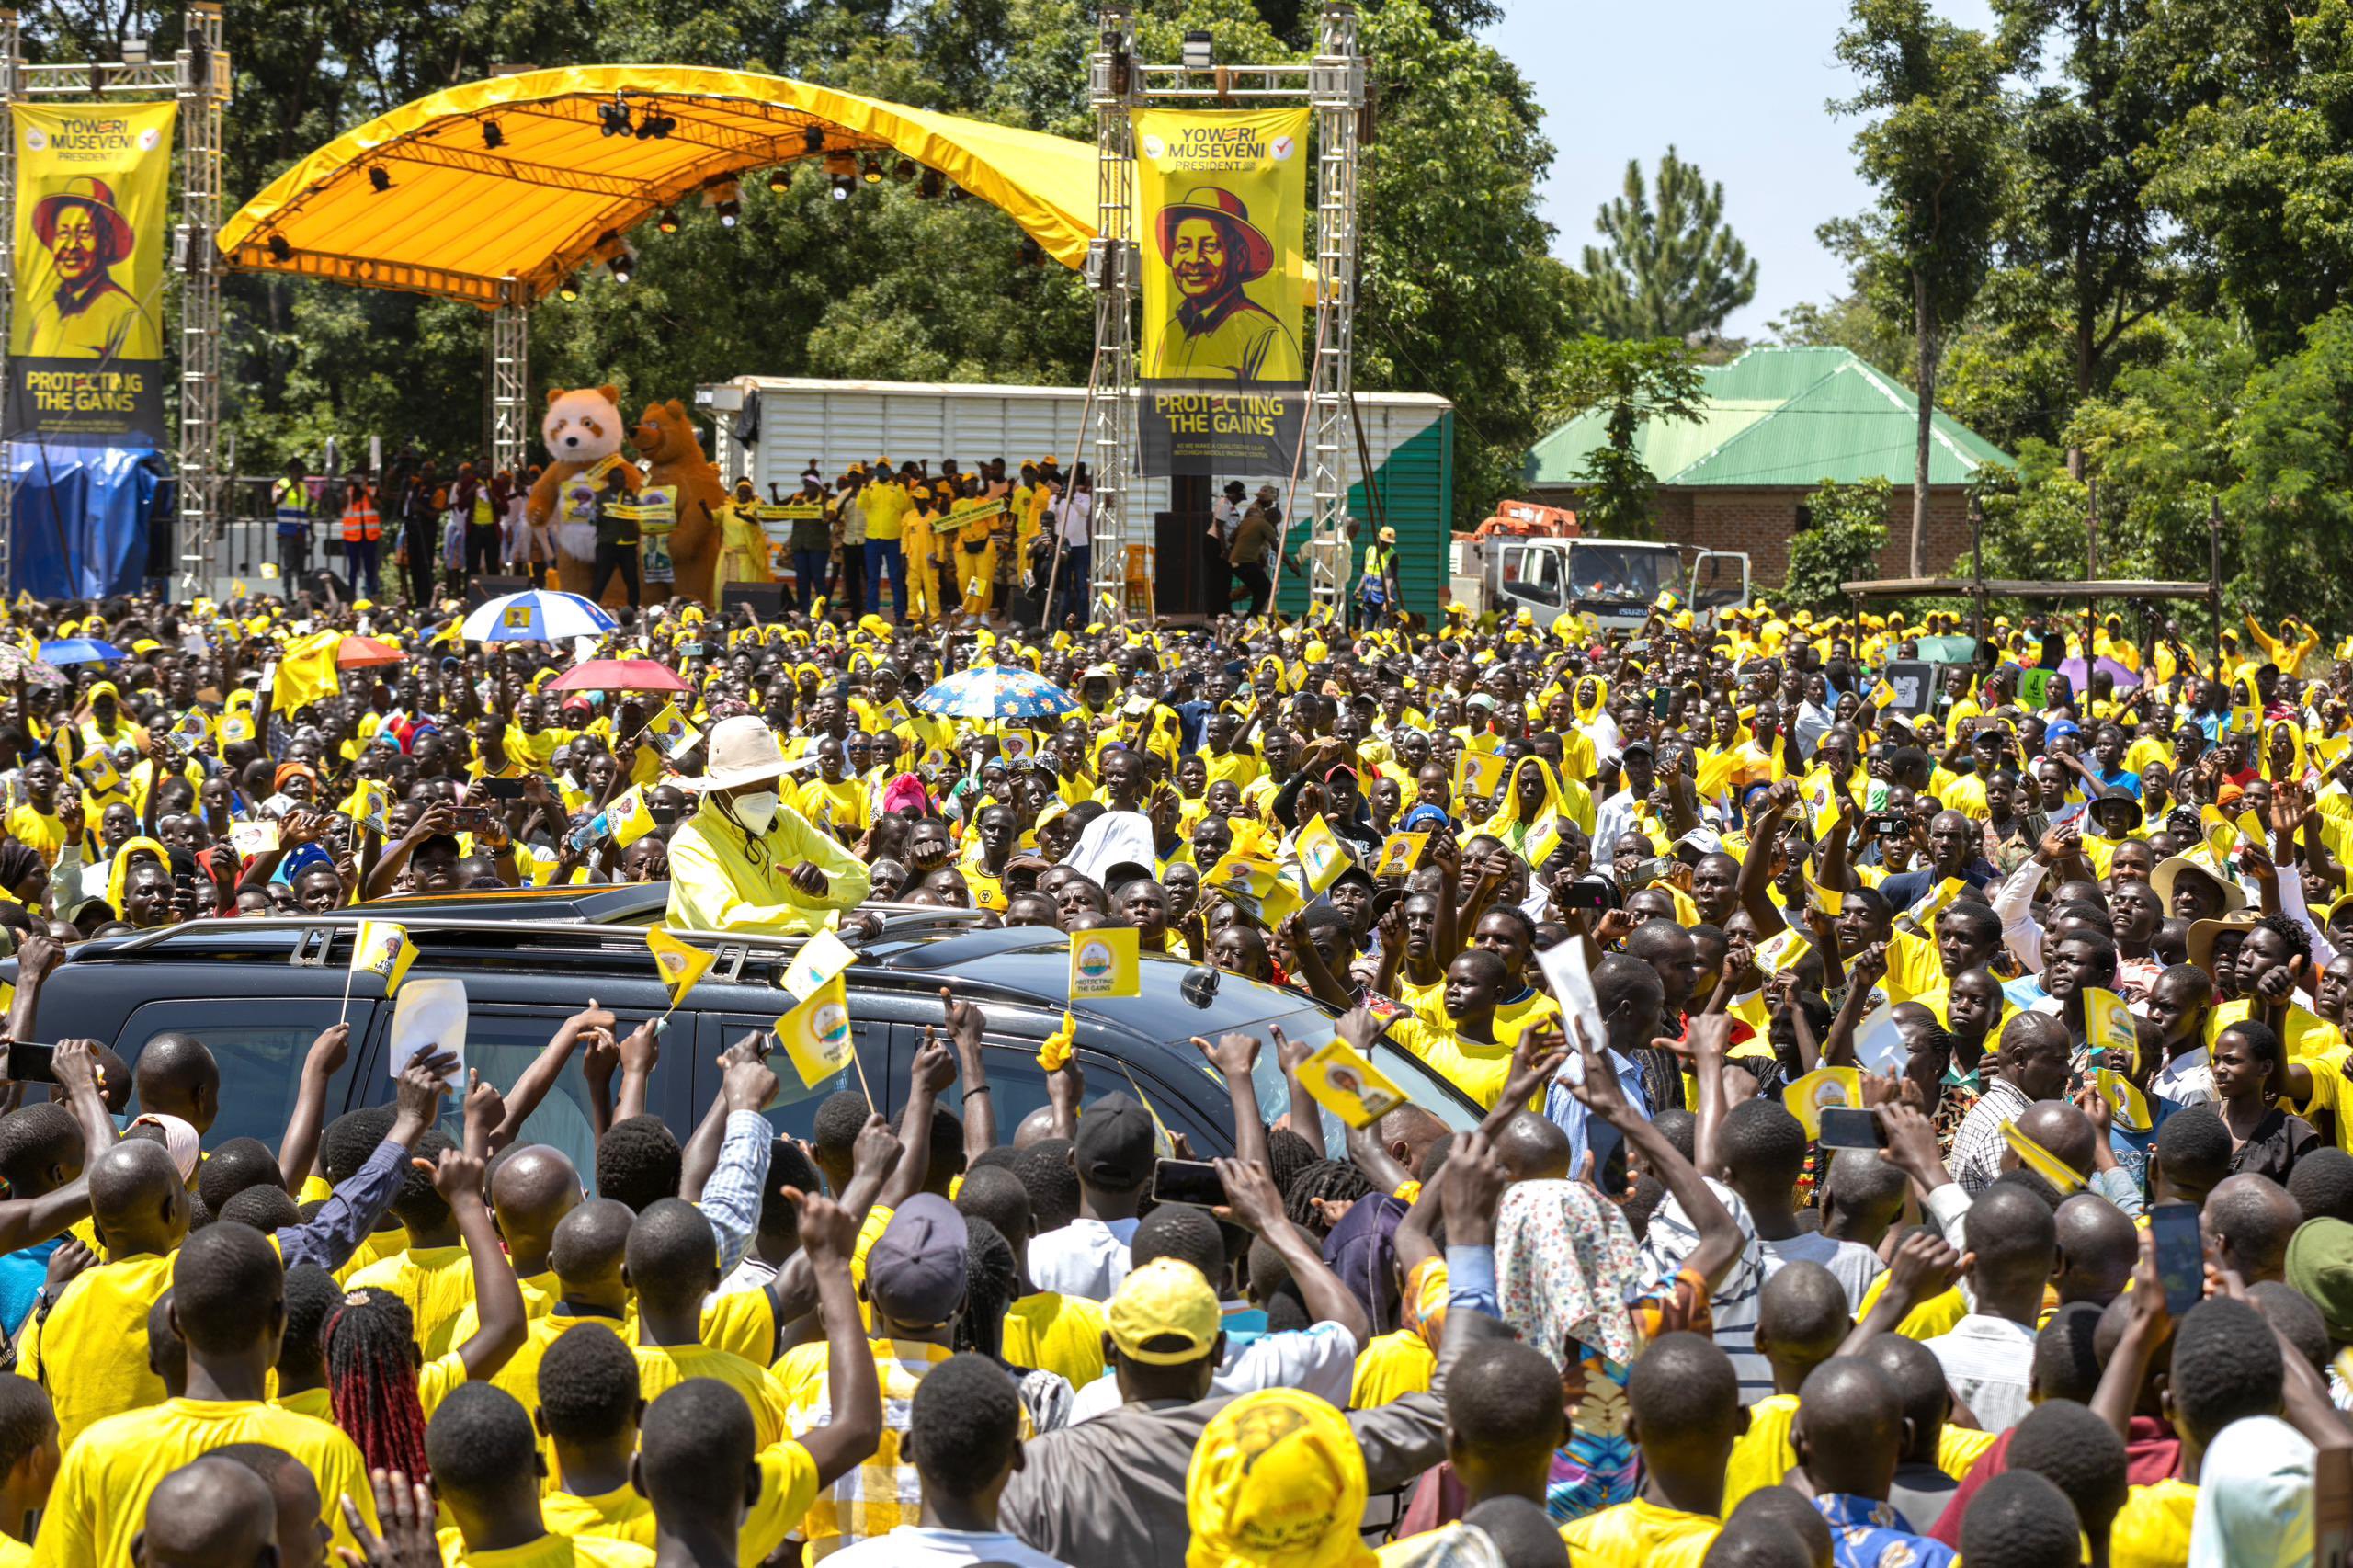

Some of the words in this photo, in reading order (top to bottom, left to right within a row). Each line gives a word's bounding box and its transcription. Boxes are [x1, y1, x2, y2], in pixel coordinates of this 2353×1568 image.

[60, 119, 128, 134] YOWERI
[1182, 127, 1256, 142] YOWERI
[51, 134, 135, 150] MUSEVENI
[1168, 142, 1266, 158] MUSEVENI
[1175, 161, 1241, 172] PRESIDENT
[33, 392, 73, 411] THE
[75, 392, 135, 412] GAINS
[1155, 393, 1284, 416] PROTECTING
[1165, 414, 1209, 434] THE
[1213, 415, 1275, 437] GAINS
[1619, 608, 1647, 616] ISUZU
